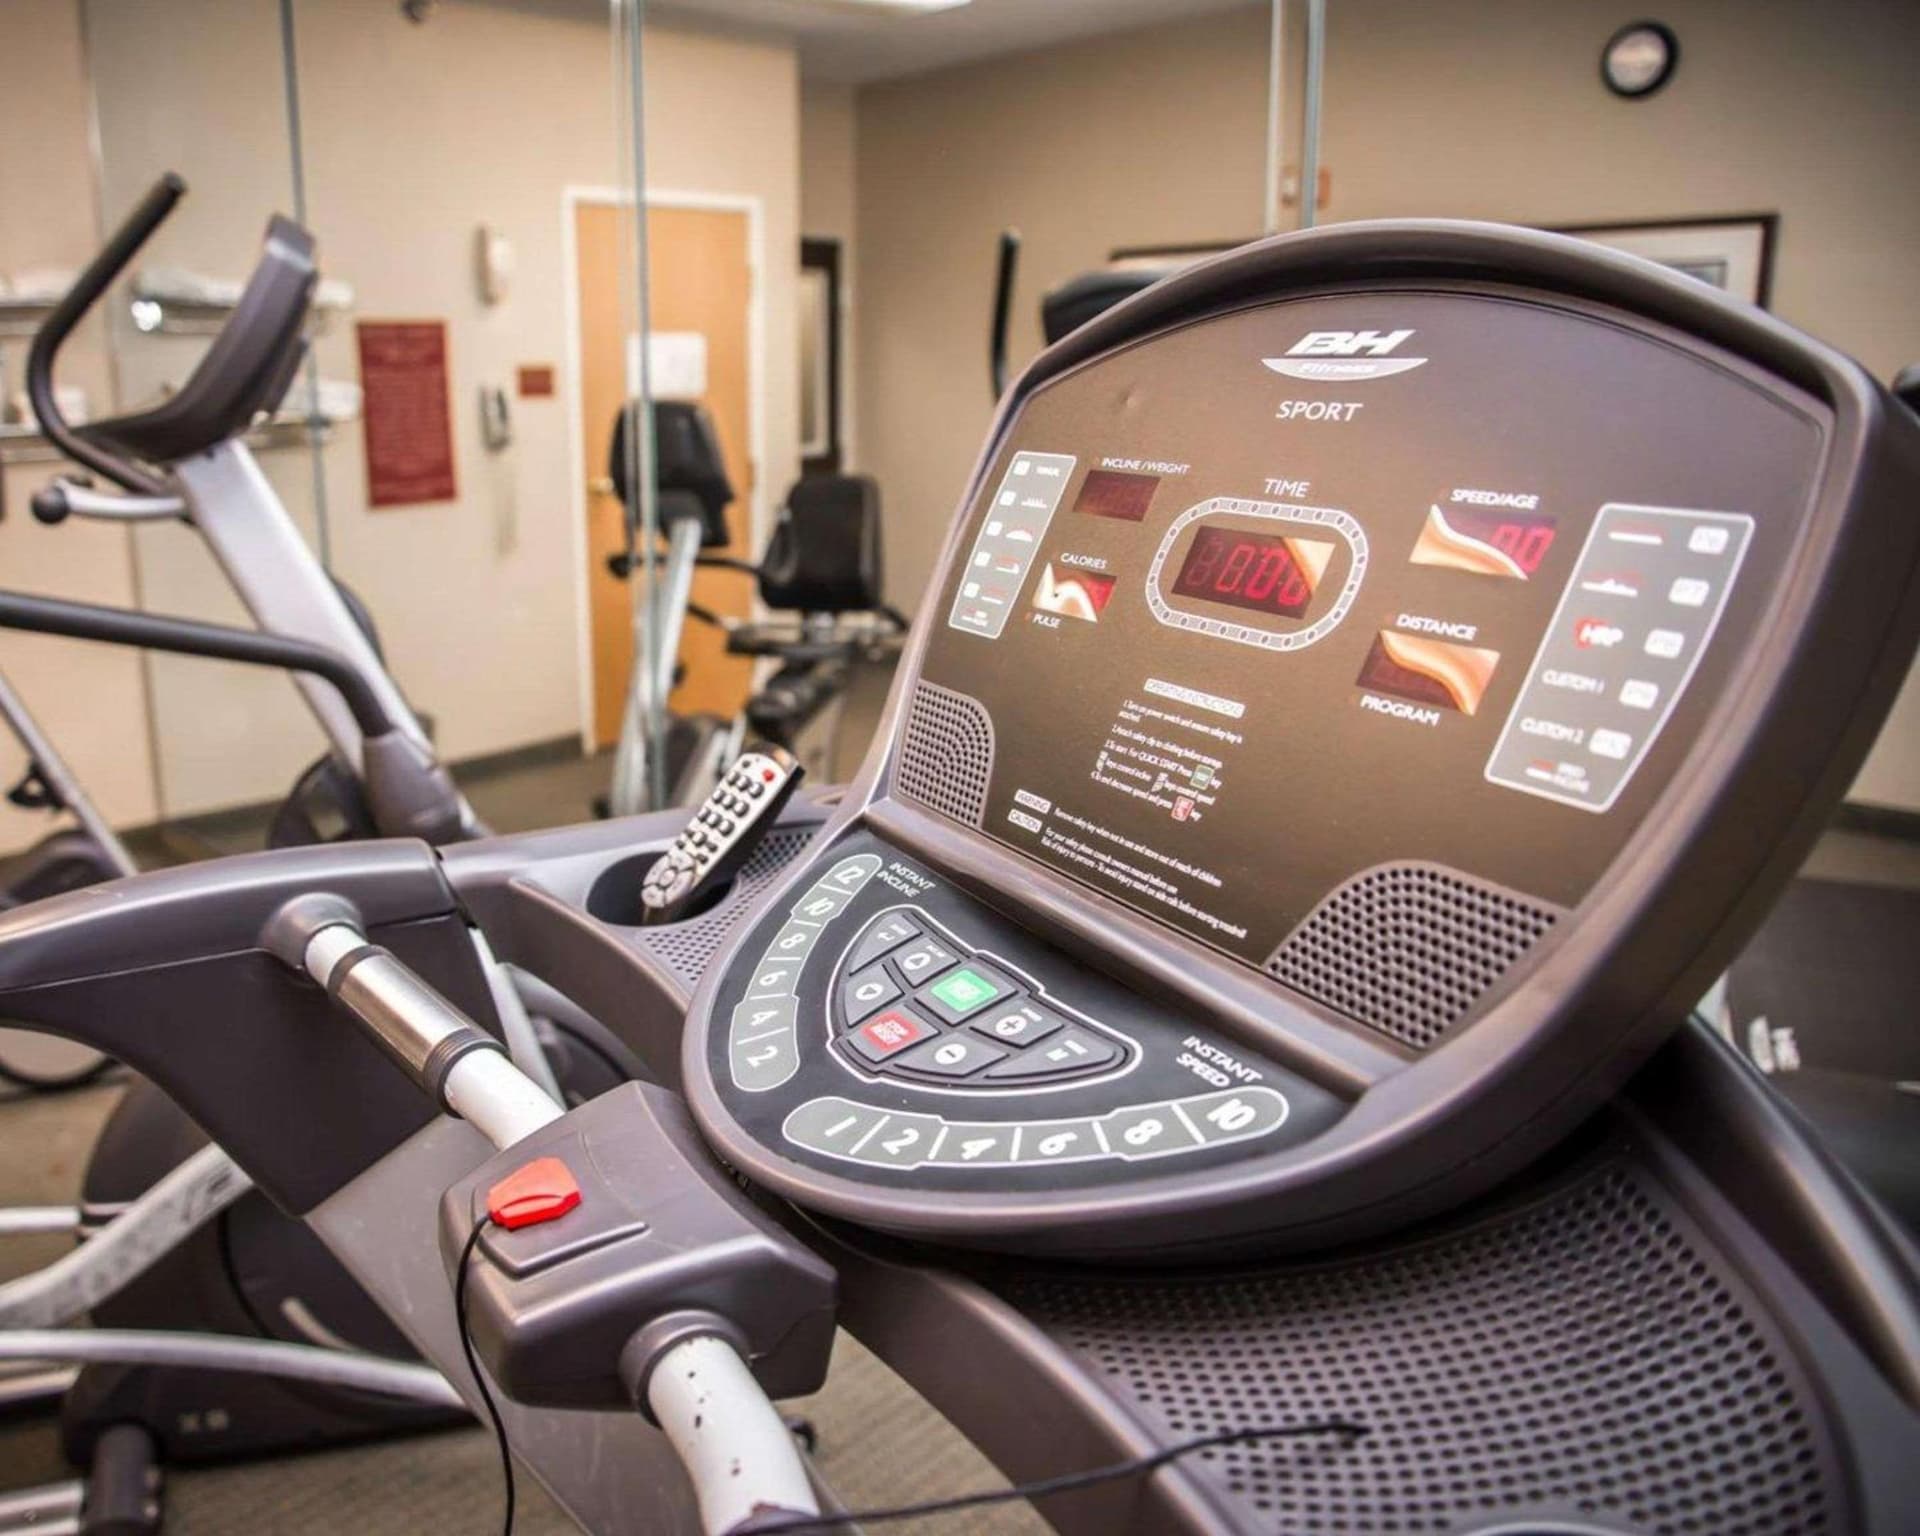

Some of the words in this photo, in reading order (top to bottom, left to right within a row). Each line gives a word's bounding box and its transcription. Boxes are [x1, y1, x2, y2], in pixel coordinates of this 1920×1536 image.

[1284, 329, 1416, 356] BH
[1275, 400, 1364, 421] SPORT
[1264, 478, 1311, 498] TIME
[1060, 552, 1109, 570] CALORIES
[1396, 614, 1478, 641] DISTANCE
[1360, 695, 1441, 727] PROGRAM
[889, 862, 936, 890] INSTANT
[803, 897, 835, 916] 10
[780, 932, 806, 949] 8
[759, 971, 788, 986] 6
[751, 1010, 779, 1027] 4
[746, 1045, 778, 1068] 2
[1182, 1035, 1263, 1083] INSTANT
[1176, 1053, 1230, 1087] SPEED
[824, 1117, 857, 1138] 1
[881, 1128, 920, 1155] 2
[961, 1138, 996, 1160] 4
[1038, 1132, 1079, 1155] 6
[1123, 1118, 1163, 1145] 8
[1206, 1098, 1257, 1131] 10
